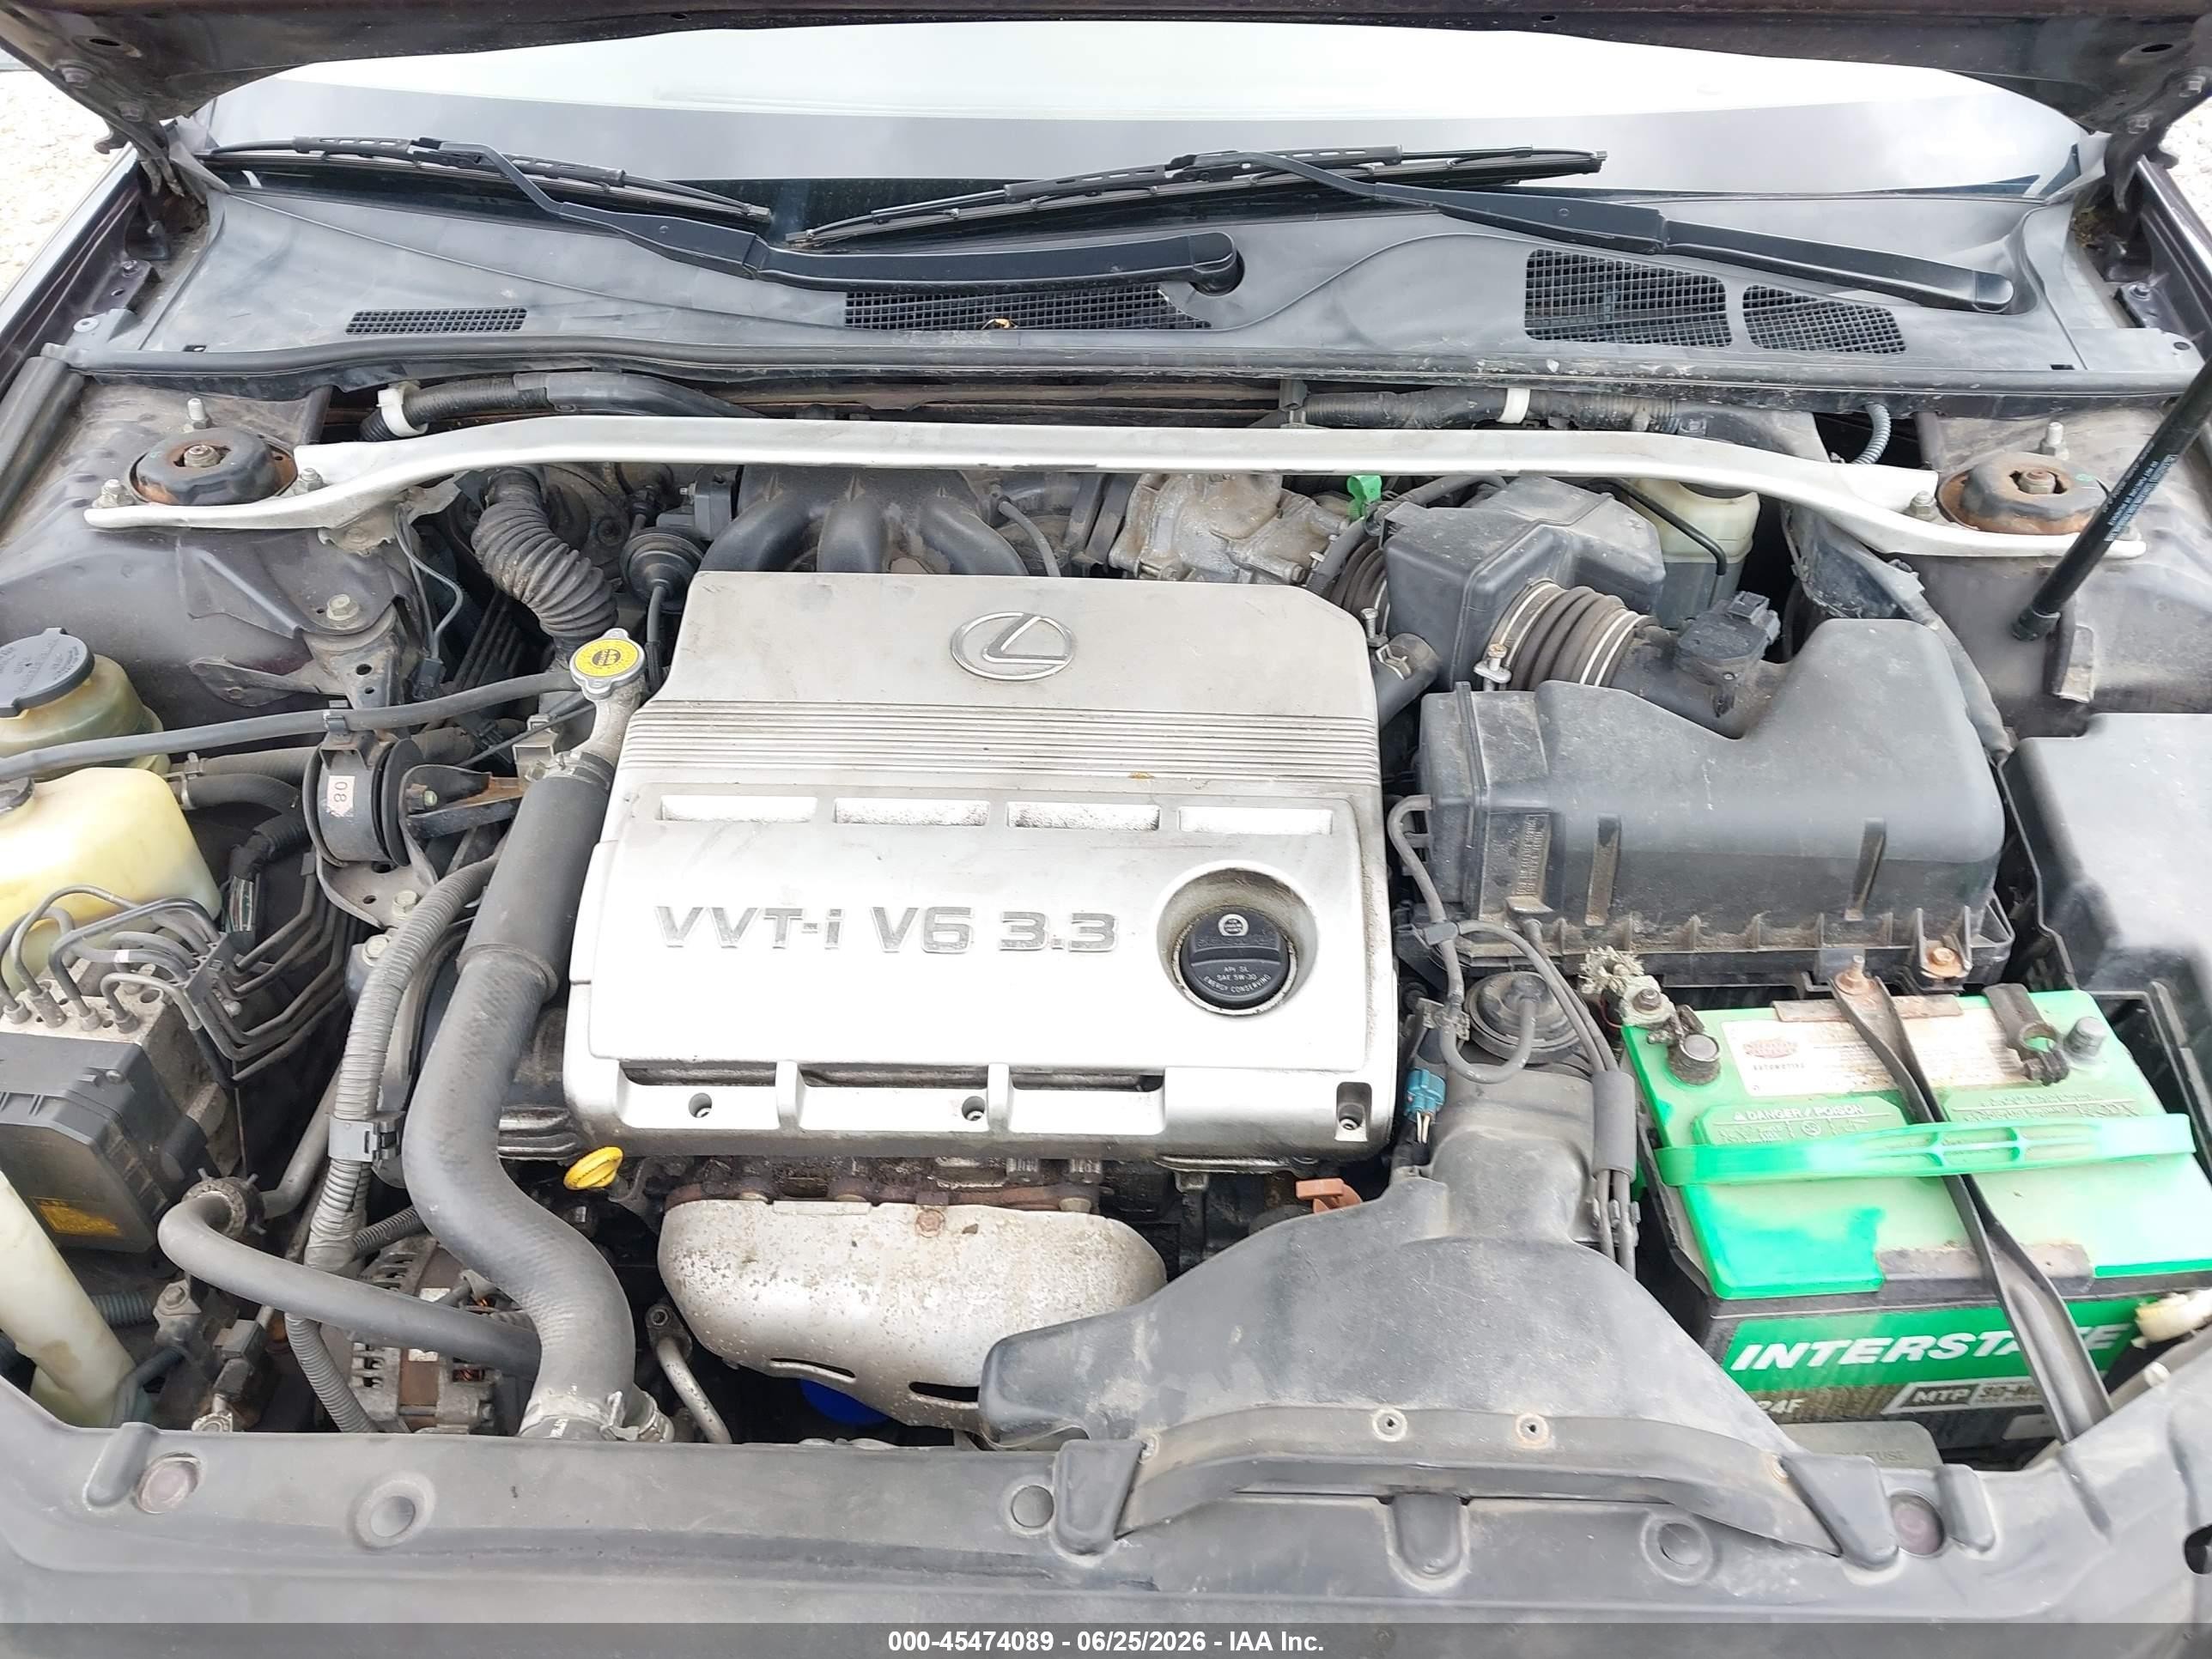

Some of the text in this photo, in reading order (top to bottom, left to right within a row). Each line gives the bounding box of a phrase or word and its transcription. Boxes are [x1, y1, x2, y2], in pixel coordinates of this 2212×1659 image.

[655, 906, 1119, 955] VVT-i V6 3.3
[1203, 974, 1272, 994] ENERGY CONSERVING
[1746, 1107, 1802, 1121] DANGER
[1813, 1104, 1865, 1116] POISON
[1912, 1388, 1972, 1403] MTP
